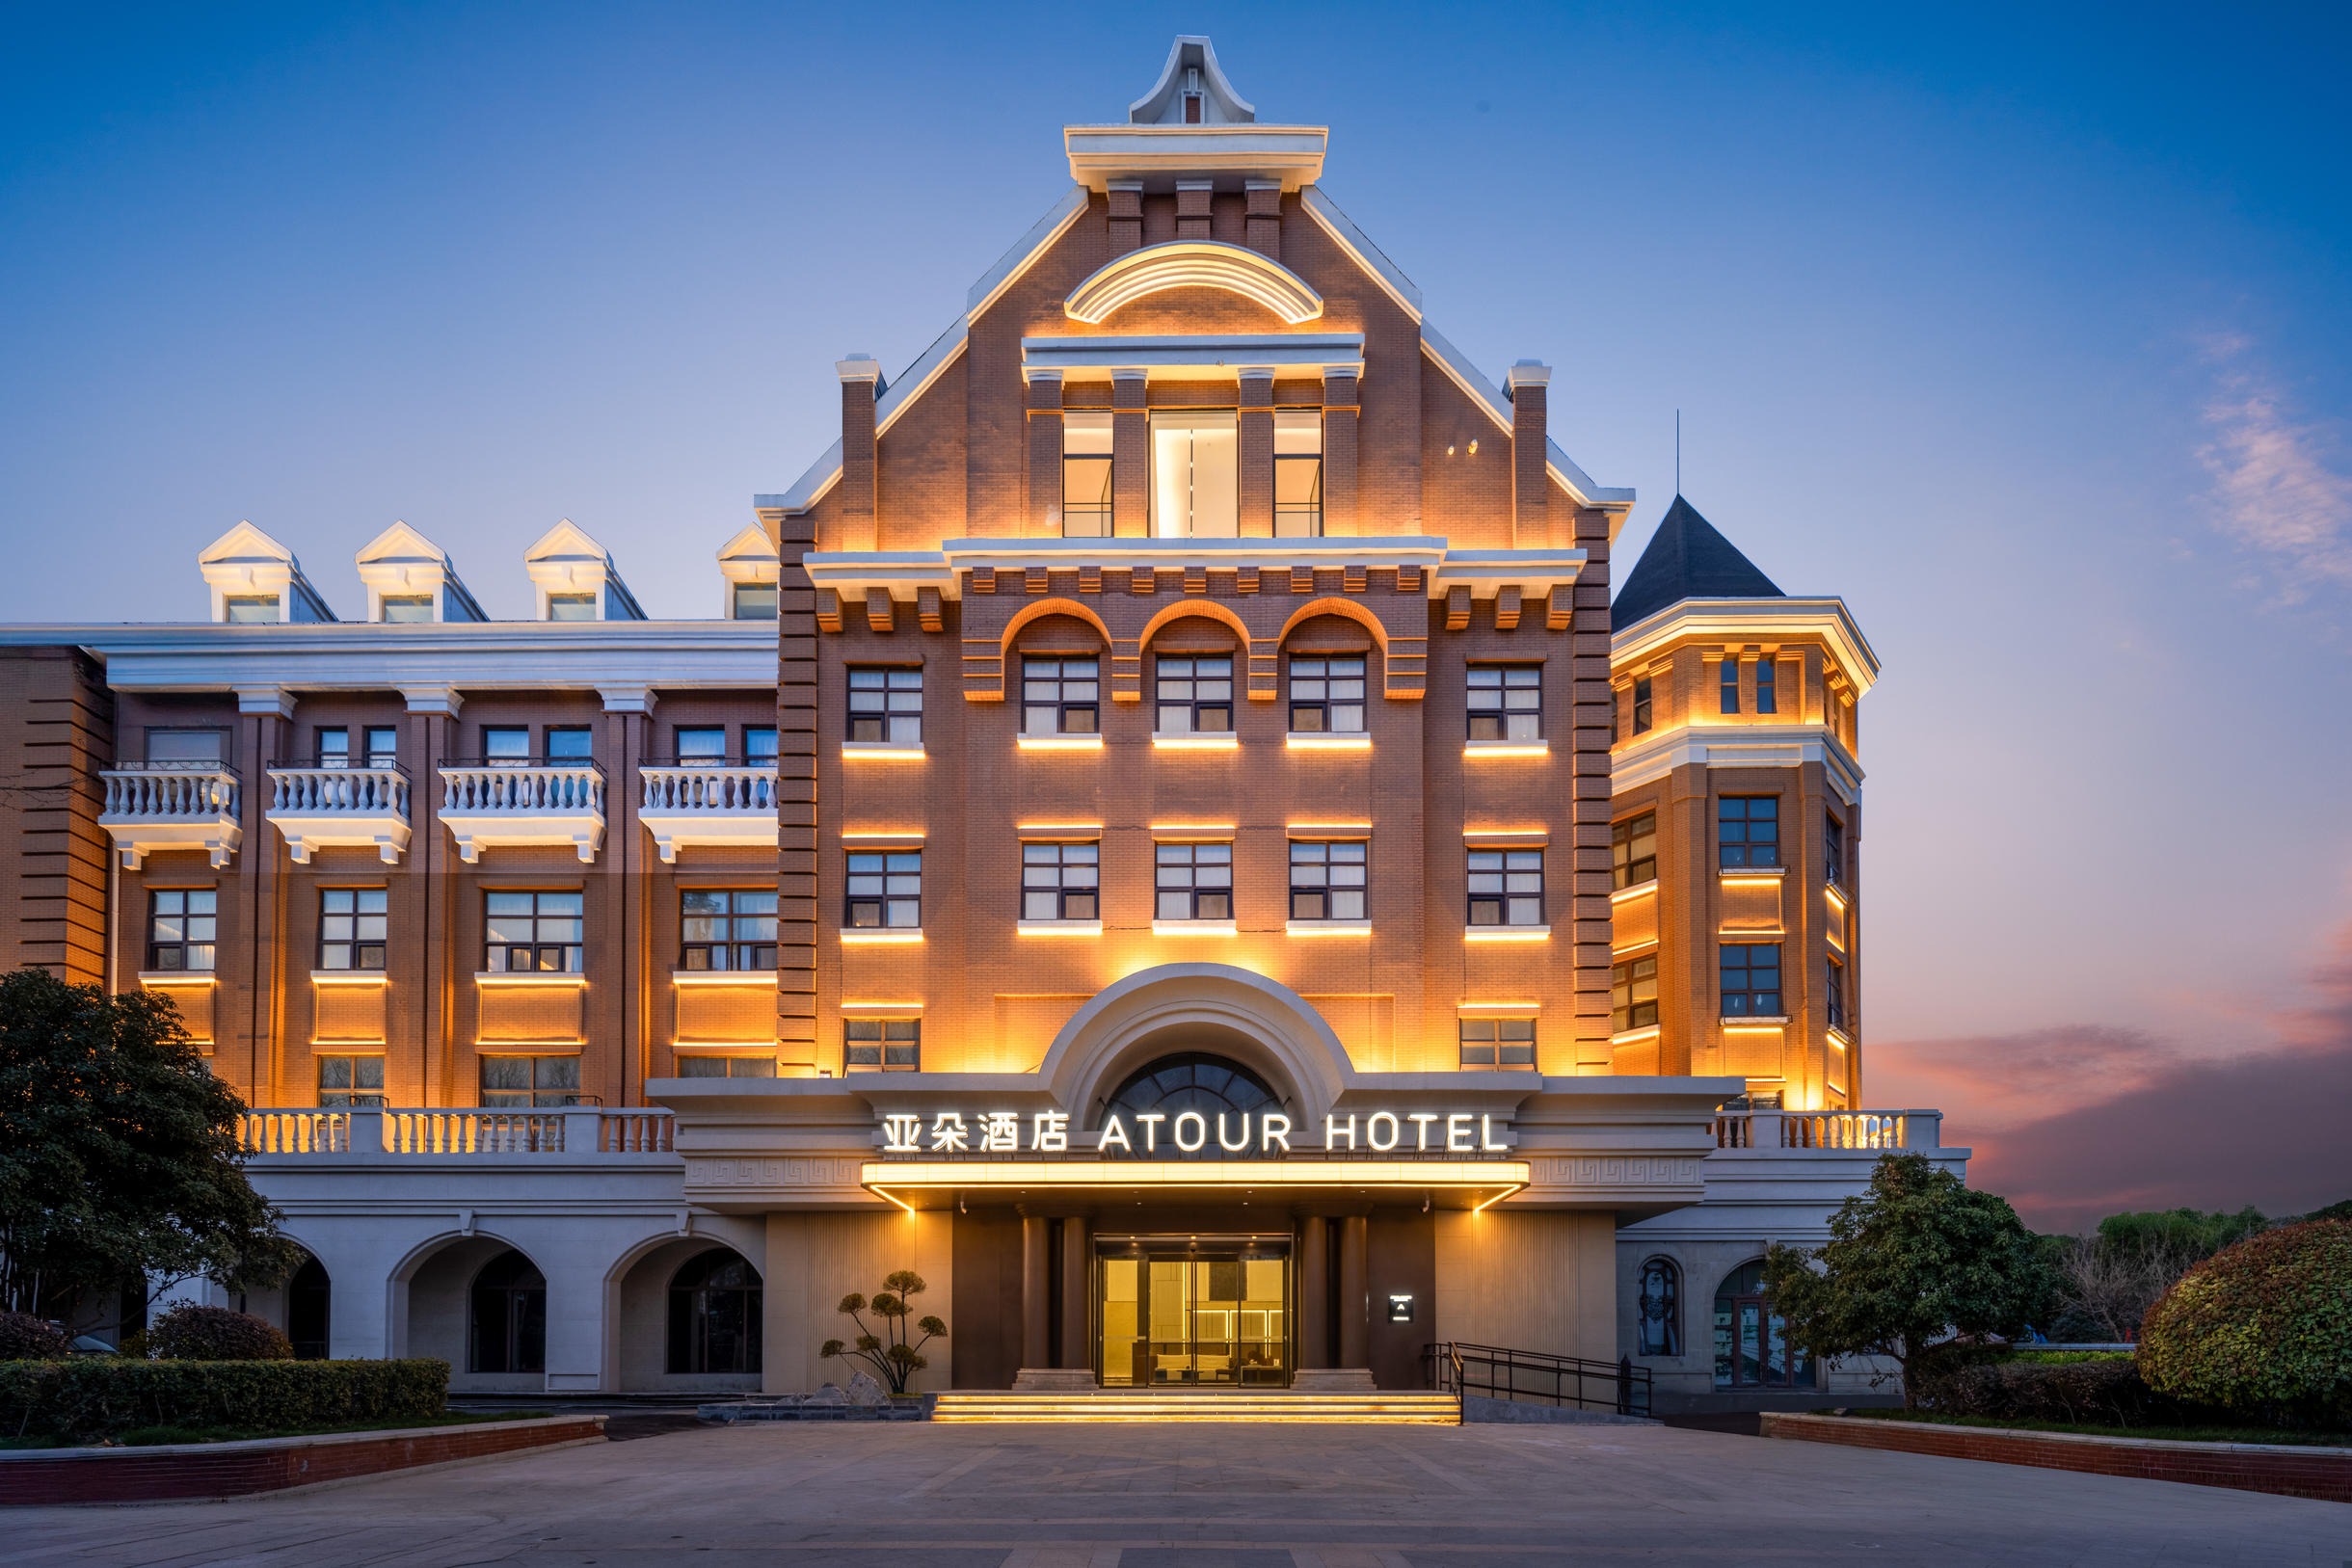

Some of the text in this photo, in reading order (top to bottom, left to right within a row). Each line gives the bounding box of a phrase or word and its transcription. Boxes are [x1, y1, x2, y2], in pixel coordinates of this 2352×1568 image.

[882, 1109, 1070, 1153] 亚朵酒店
[1097, 1111, 1510, 1152] ATOUR HOTEL
